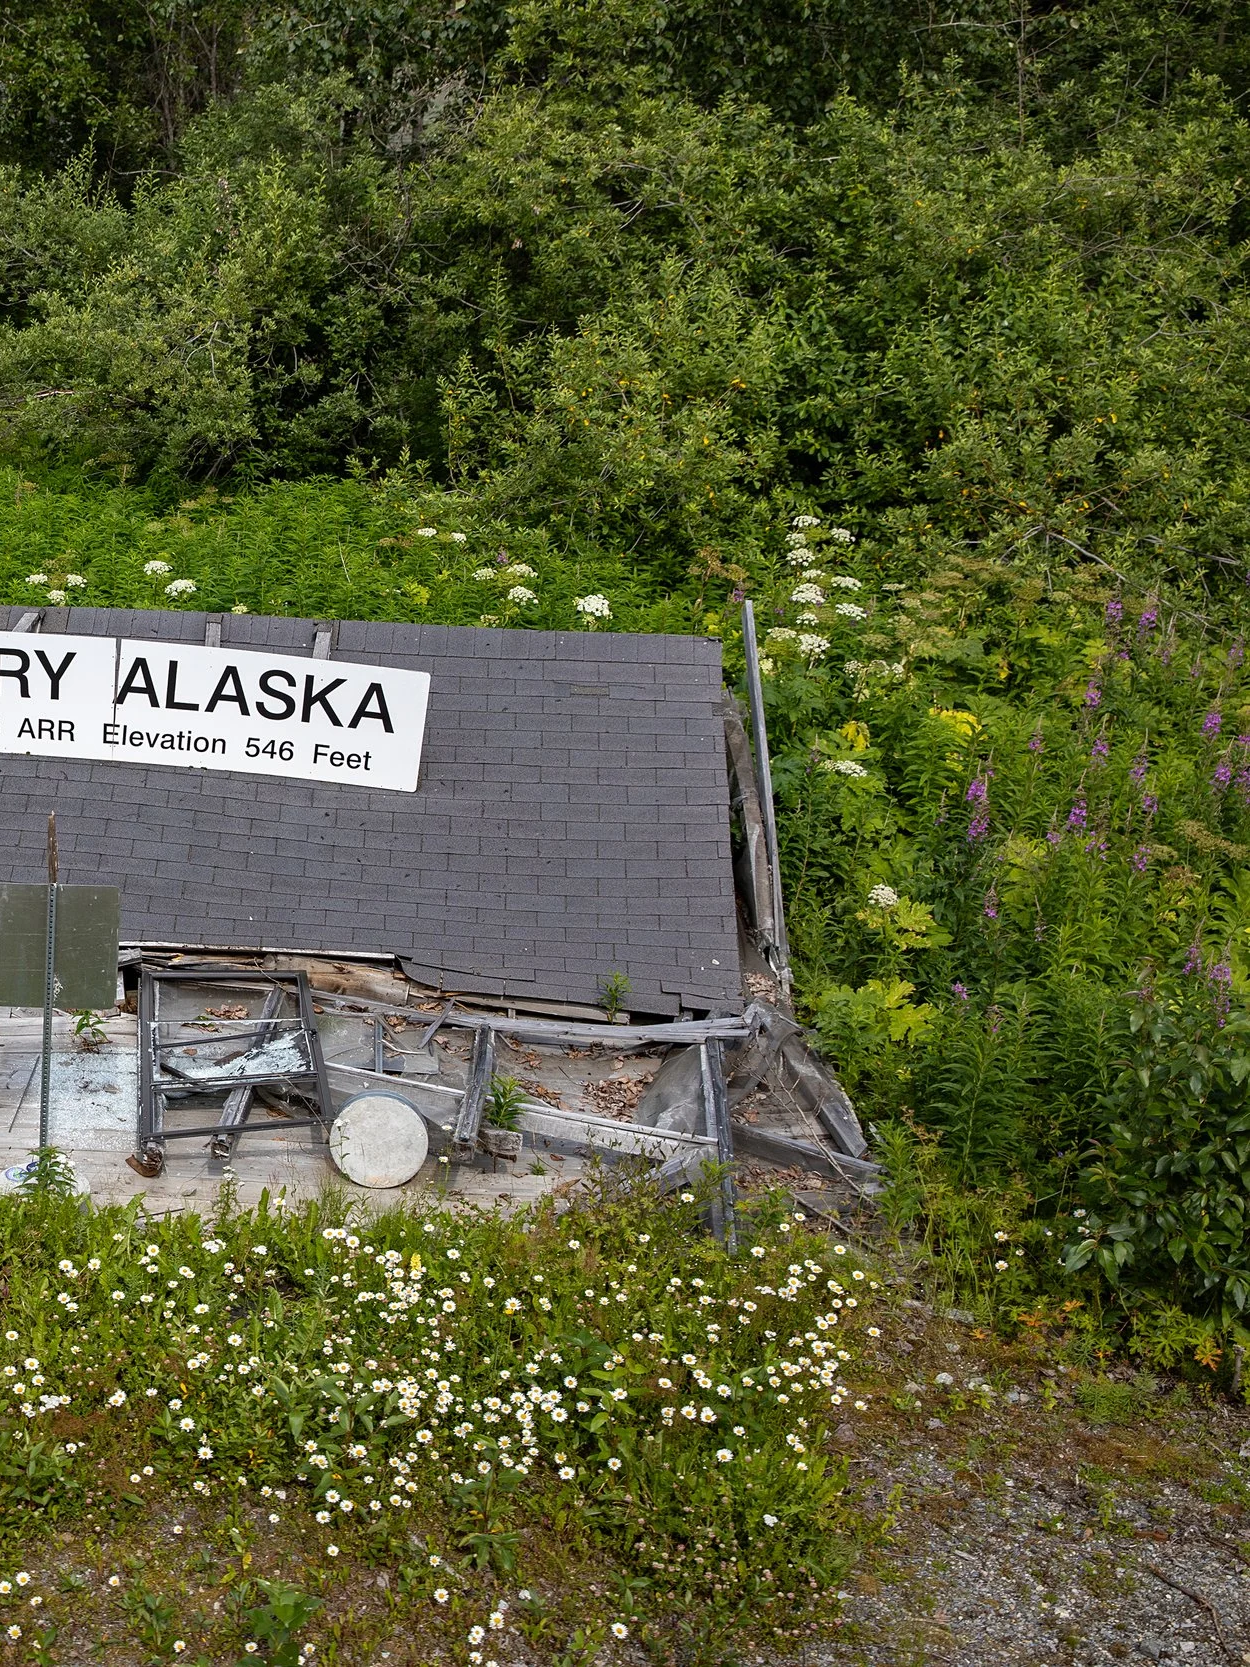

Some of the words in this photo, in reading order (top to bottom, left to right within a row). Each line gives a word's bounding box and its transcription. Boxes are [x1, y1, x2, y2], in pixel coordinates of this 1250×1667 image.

[113, 657, 395, 734] ALASKA
[17, 718, 75, 742] ARR
[102, 723, 227, 755] Elevation
[244, 738, 295, 762] 546
[312, 744, 372, 771] Feet
